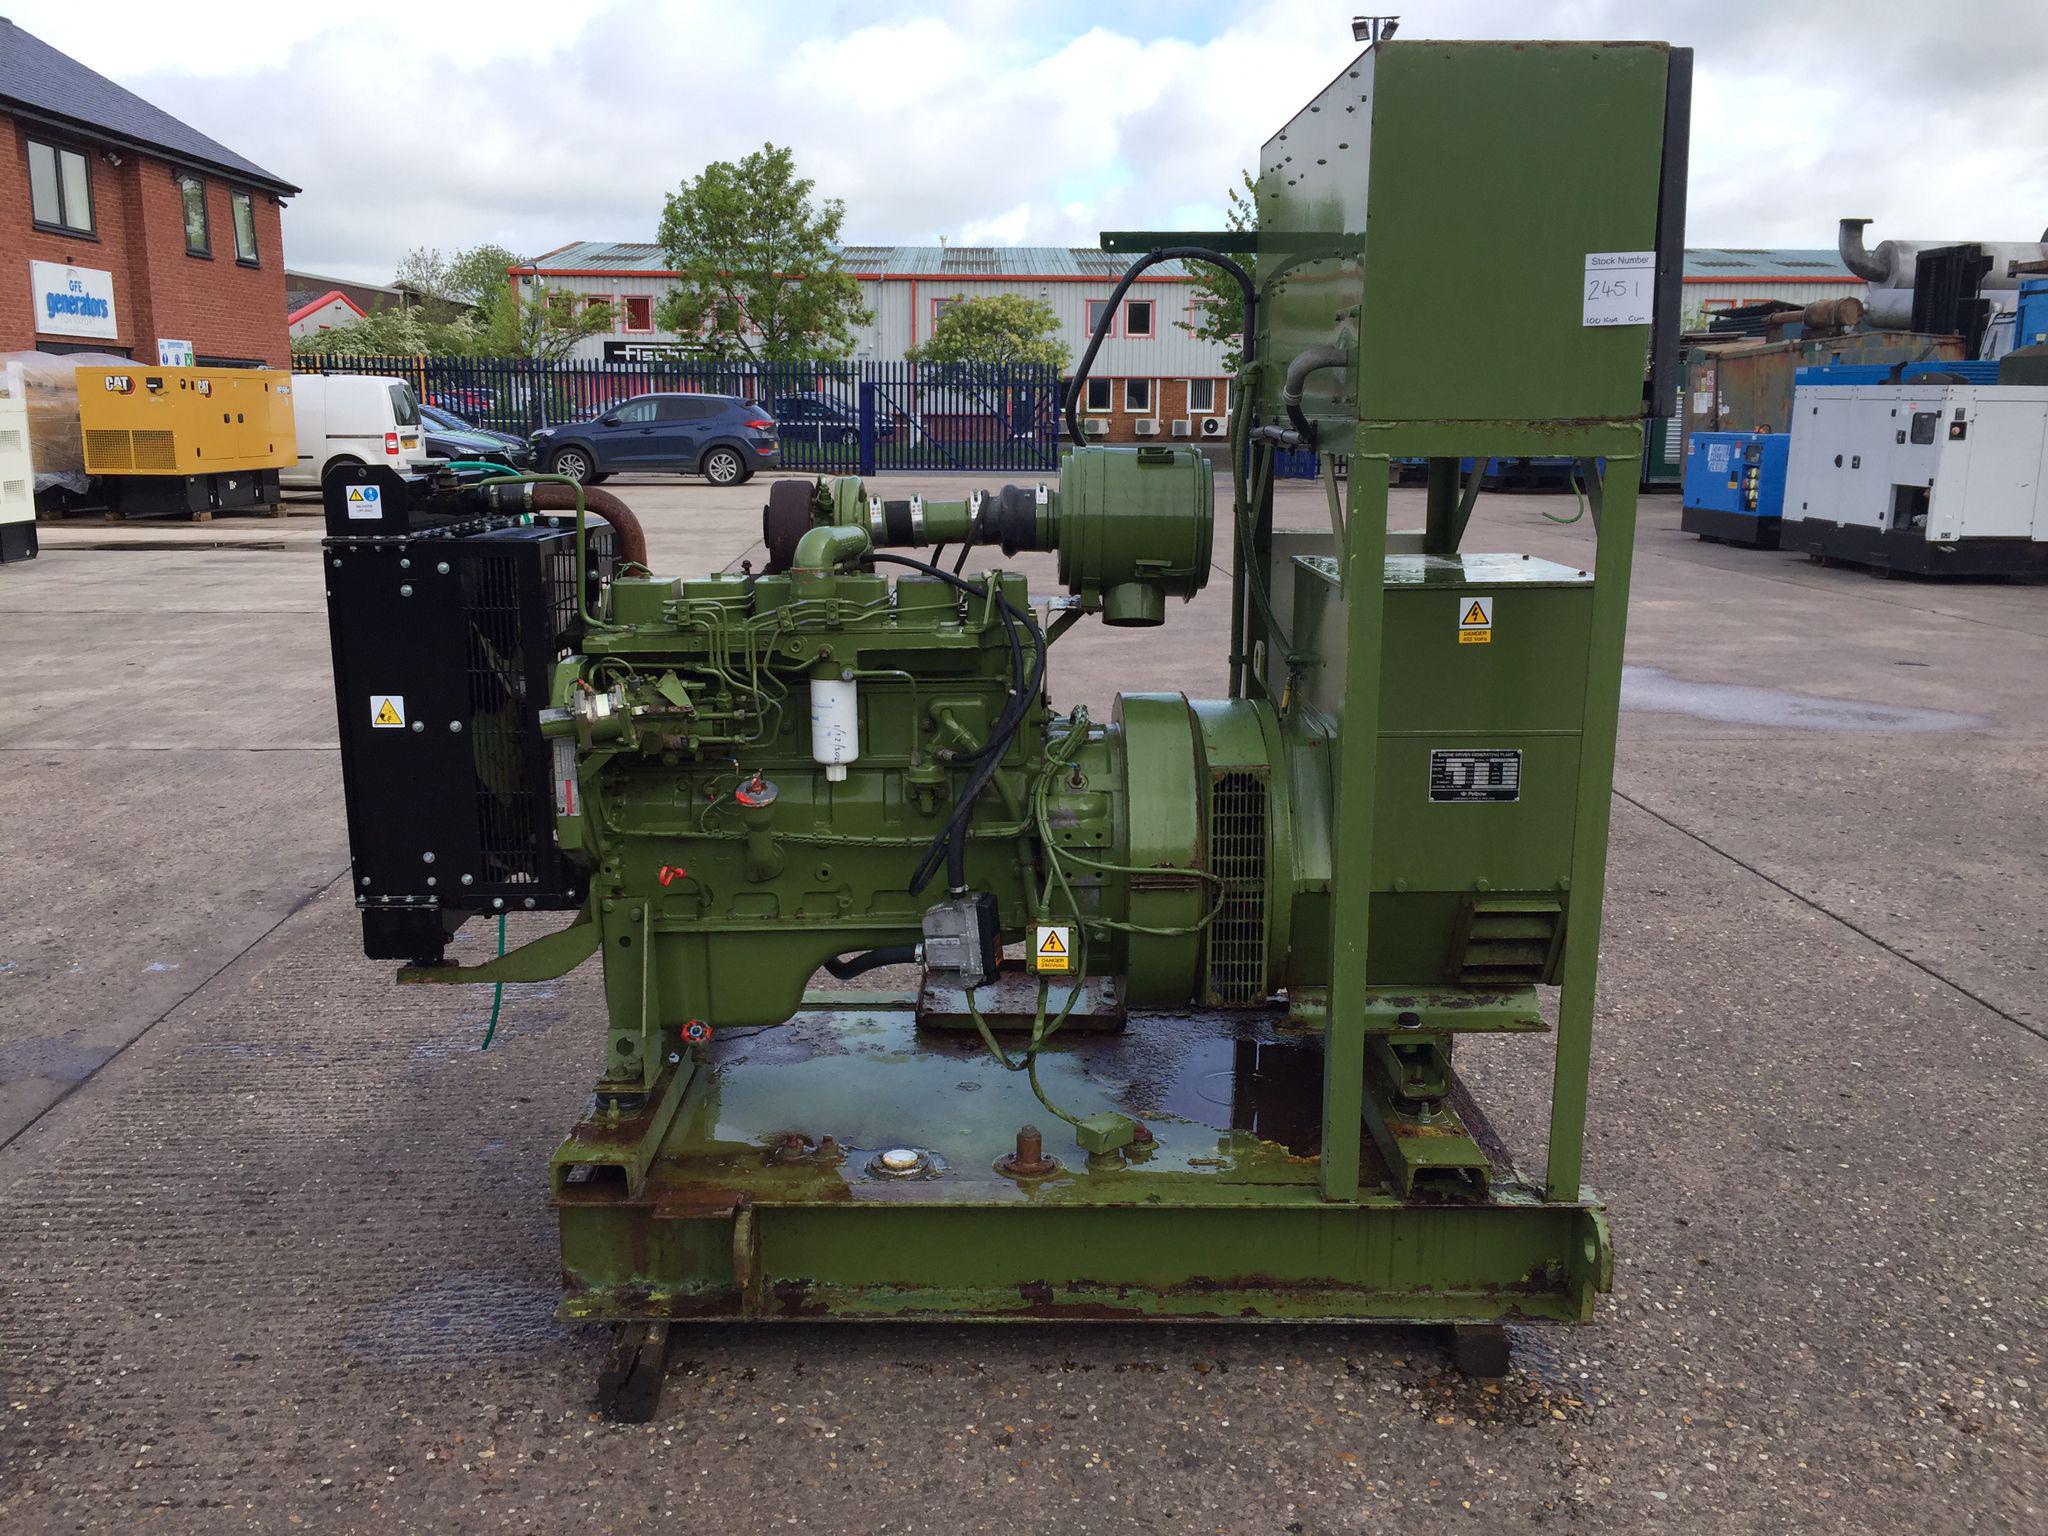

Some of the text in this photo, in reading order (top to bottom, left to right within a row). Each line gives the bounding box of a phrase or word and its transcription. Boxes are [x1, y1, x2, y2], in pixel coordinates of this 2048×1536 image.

[1592, 255, 1650, 265] Stock Number
[68, 280, 82, 293] GFE
[1587, 279, 1639, 301] 2451
[47, 292, 108, 318] generators
[104, 376, 129, 391] CAT
[197, 379, 209, 395] CAT
